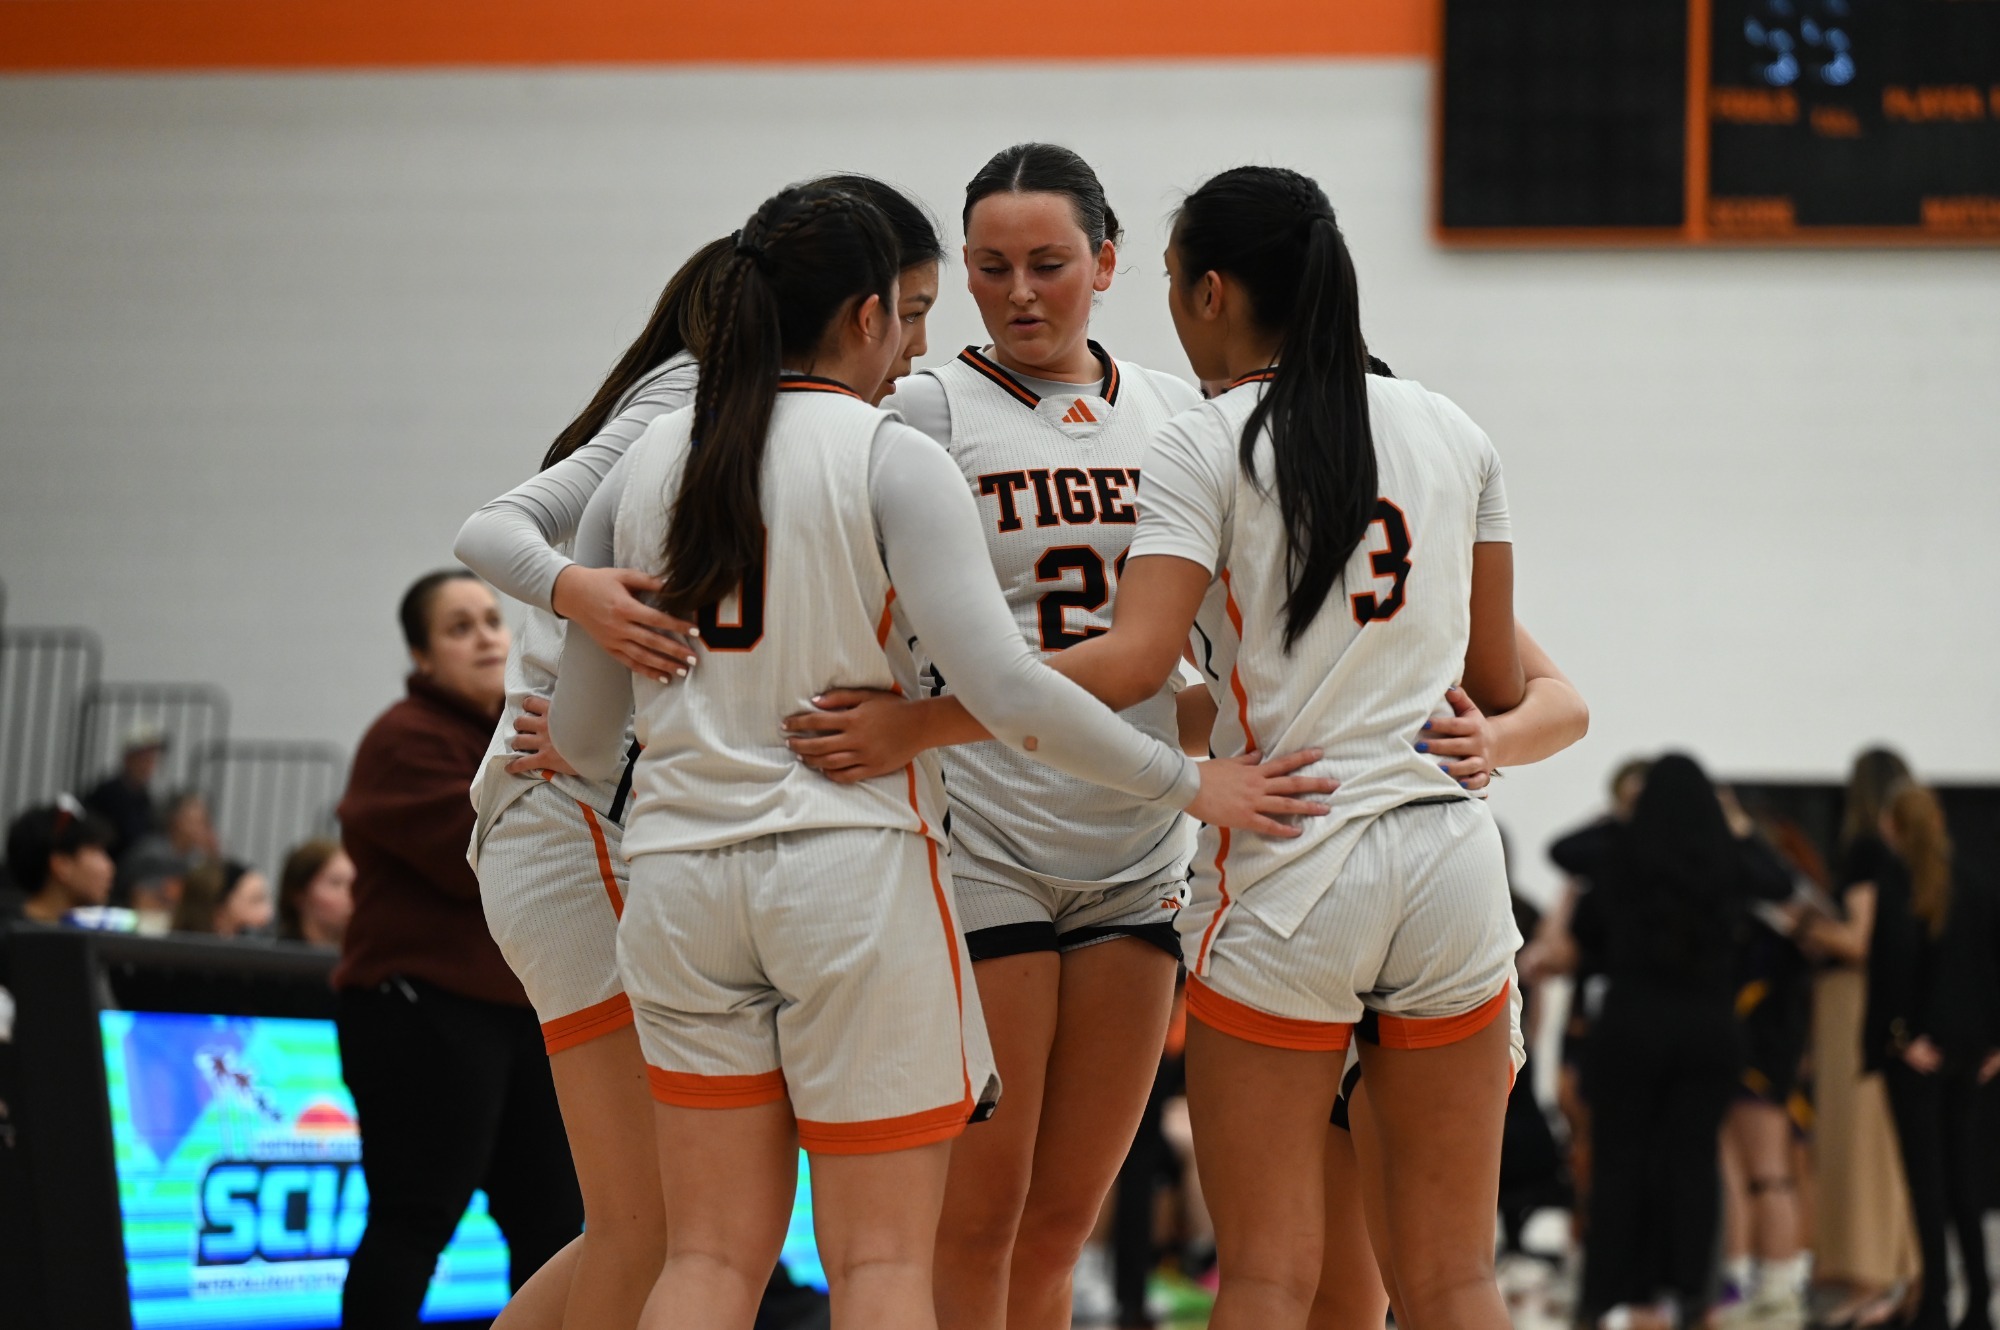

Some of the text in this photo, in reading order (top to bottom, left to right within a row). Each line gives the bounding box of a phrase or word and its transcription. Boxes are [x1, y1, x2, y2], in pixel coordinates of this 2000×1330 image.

[977, 467, 1142, 533] TIGE
[1034, 544, 1130, 652] 2
[1350, 496, 1413, 628] 3
